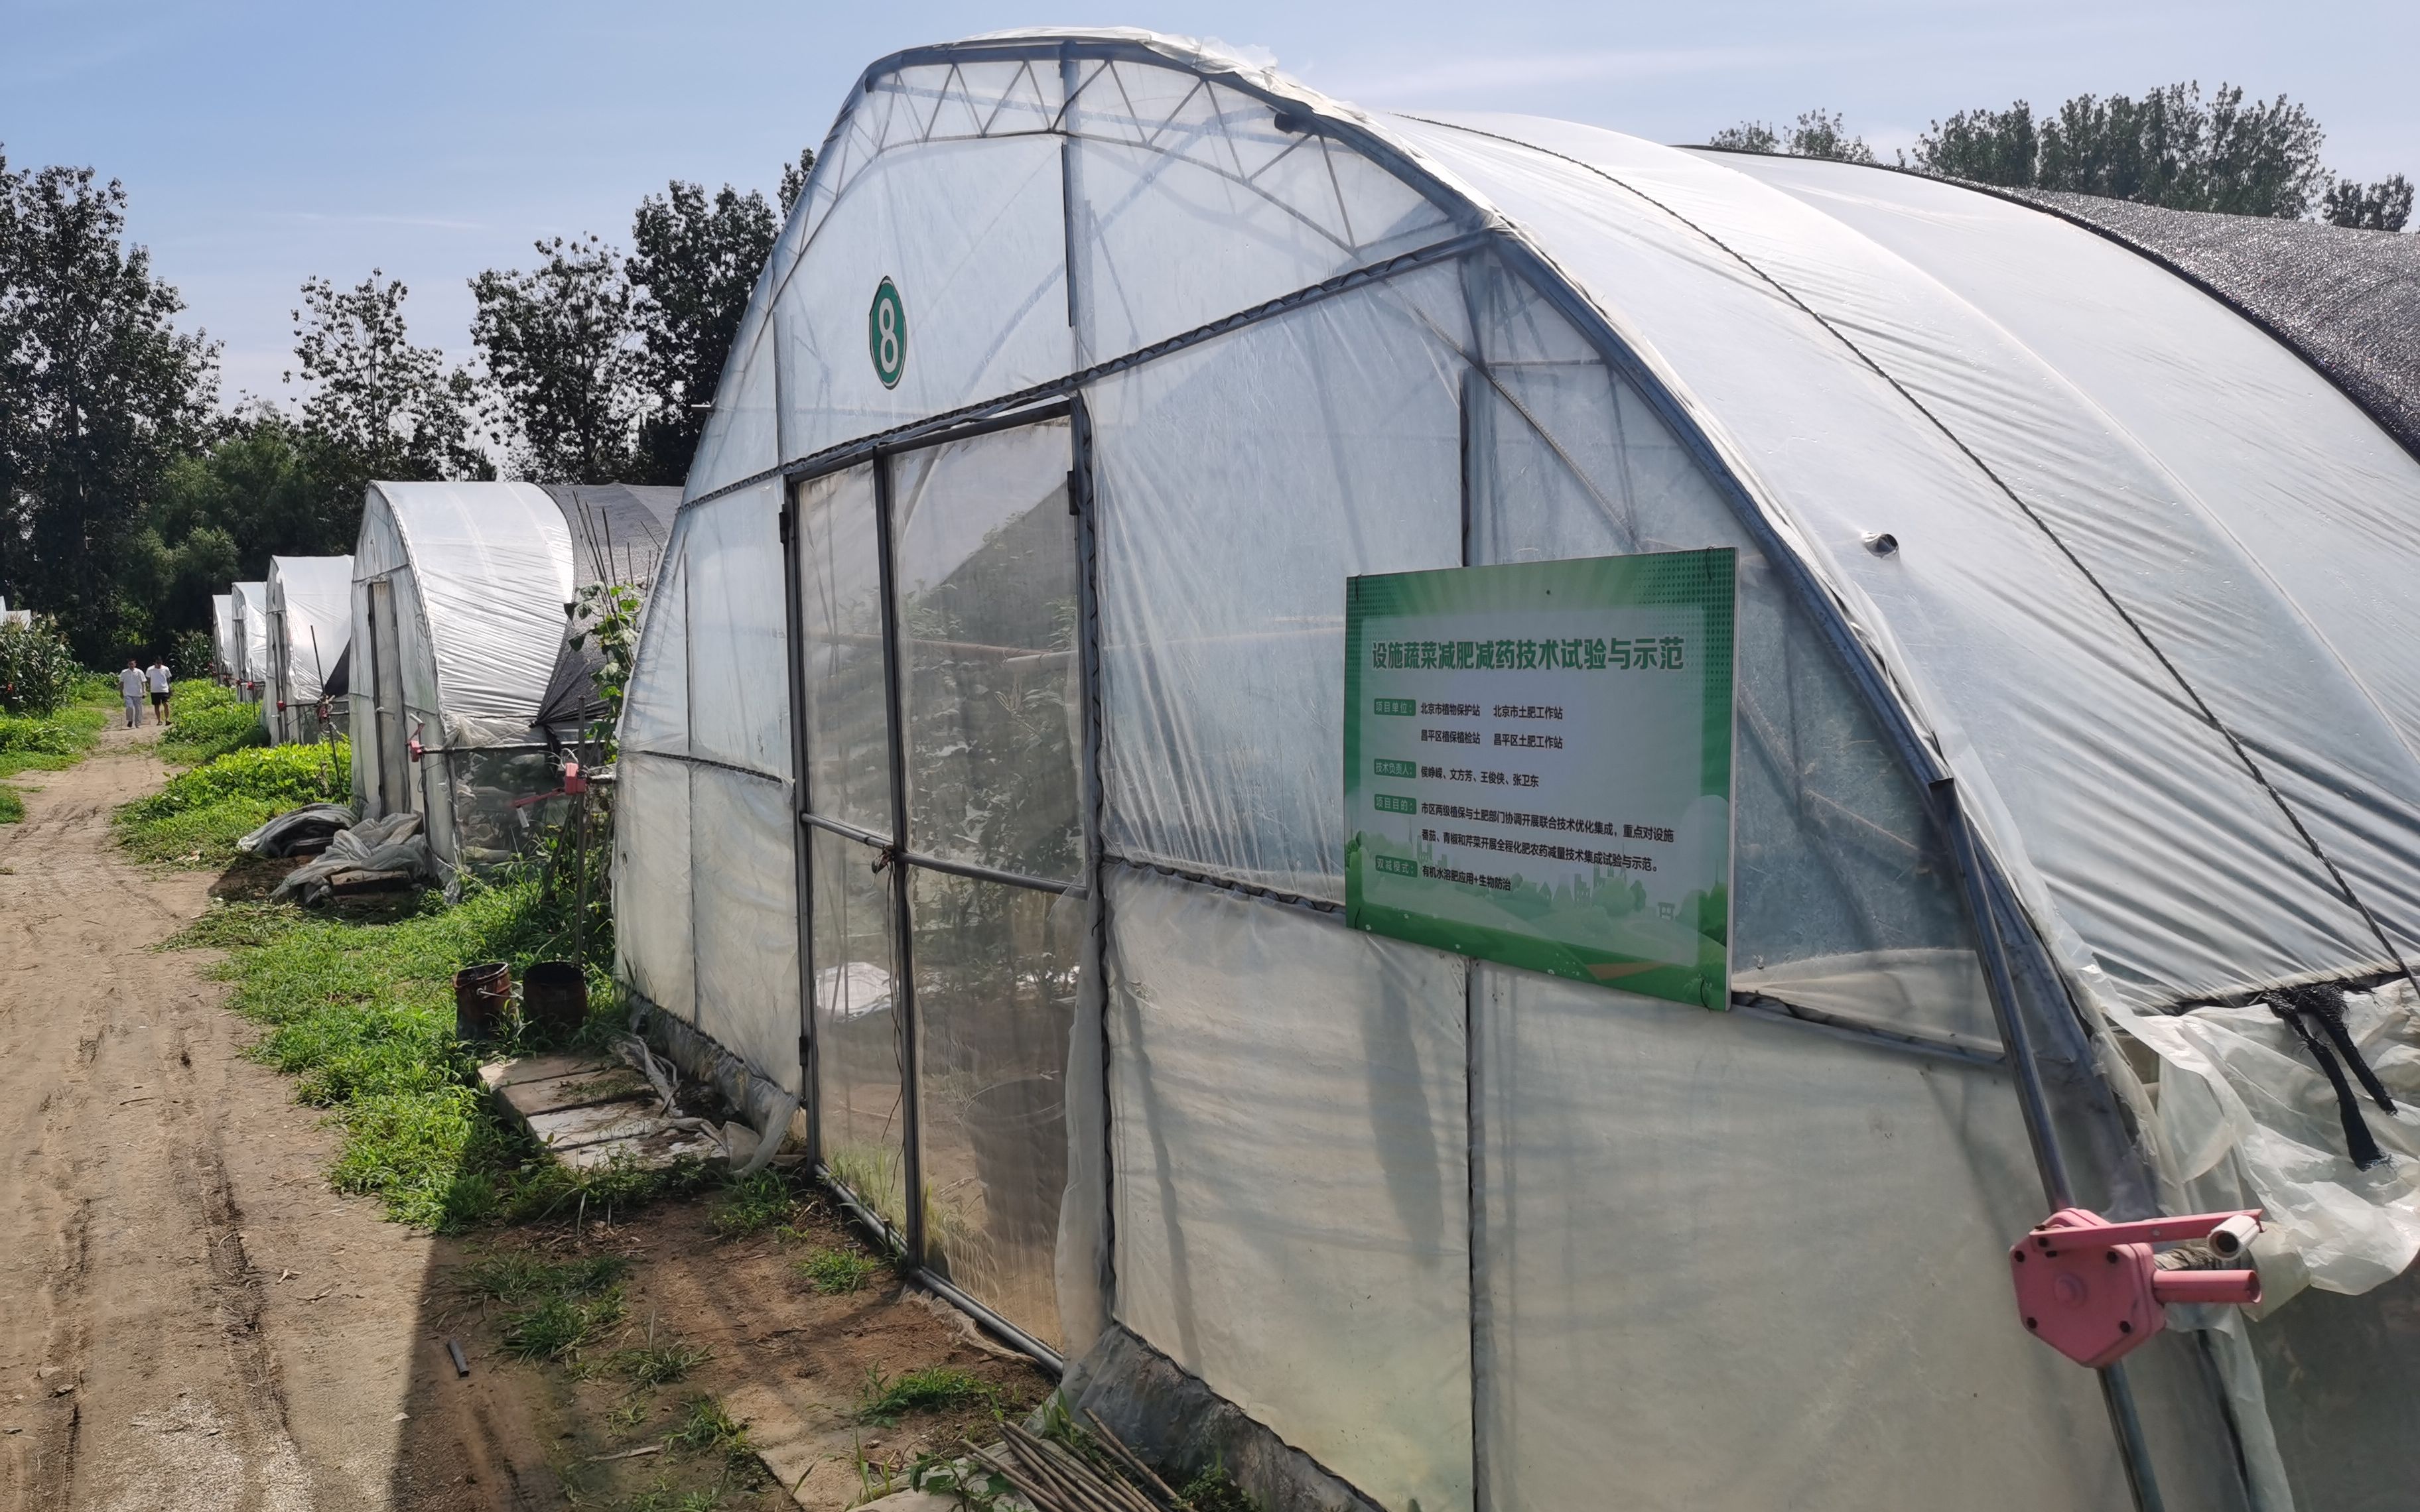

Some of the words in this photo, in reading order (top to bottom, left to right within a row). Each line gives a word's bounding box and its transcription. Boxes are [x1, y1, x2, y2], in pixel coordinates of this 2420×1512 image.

[879, 298, 899, 373] 8
[1372, 636, 1684, 670] 设施蔬菜减肥减药技术试验与示范
[1420, 702, 1480, 717] 北京市植物保护站
[1493, 704, 1563, 720] 北京市土肥工作站
[1420, 729, 1480, 745] 昌平区植保植检站
[1493, 733, 1563, 749] 昌平区土肥工作站
[1422, 865, 1511, 891] 有机水溶肥应用+生物防治
